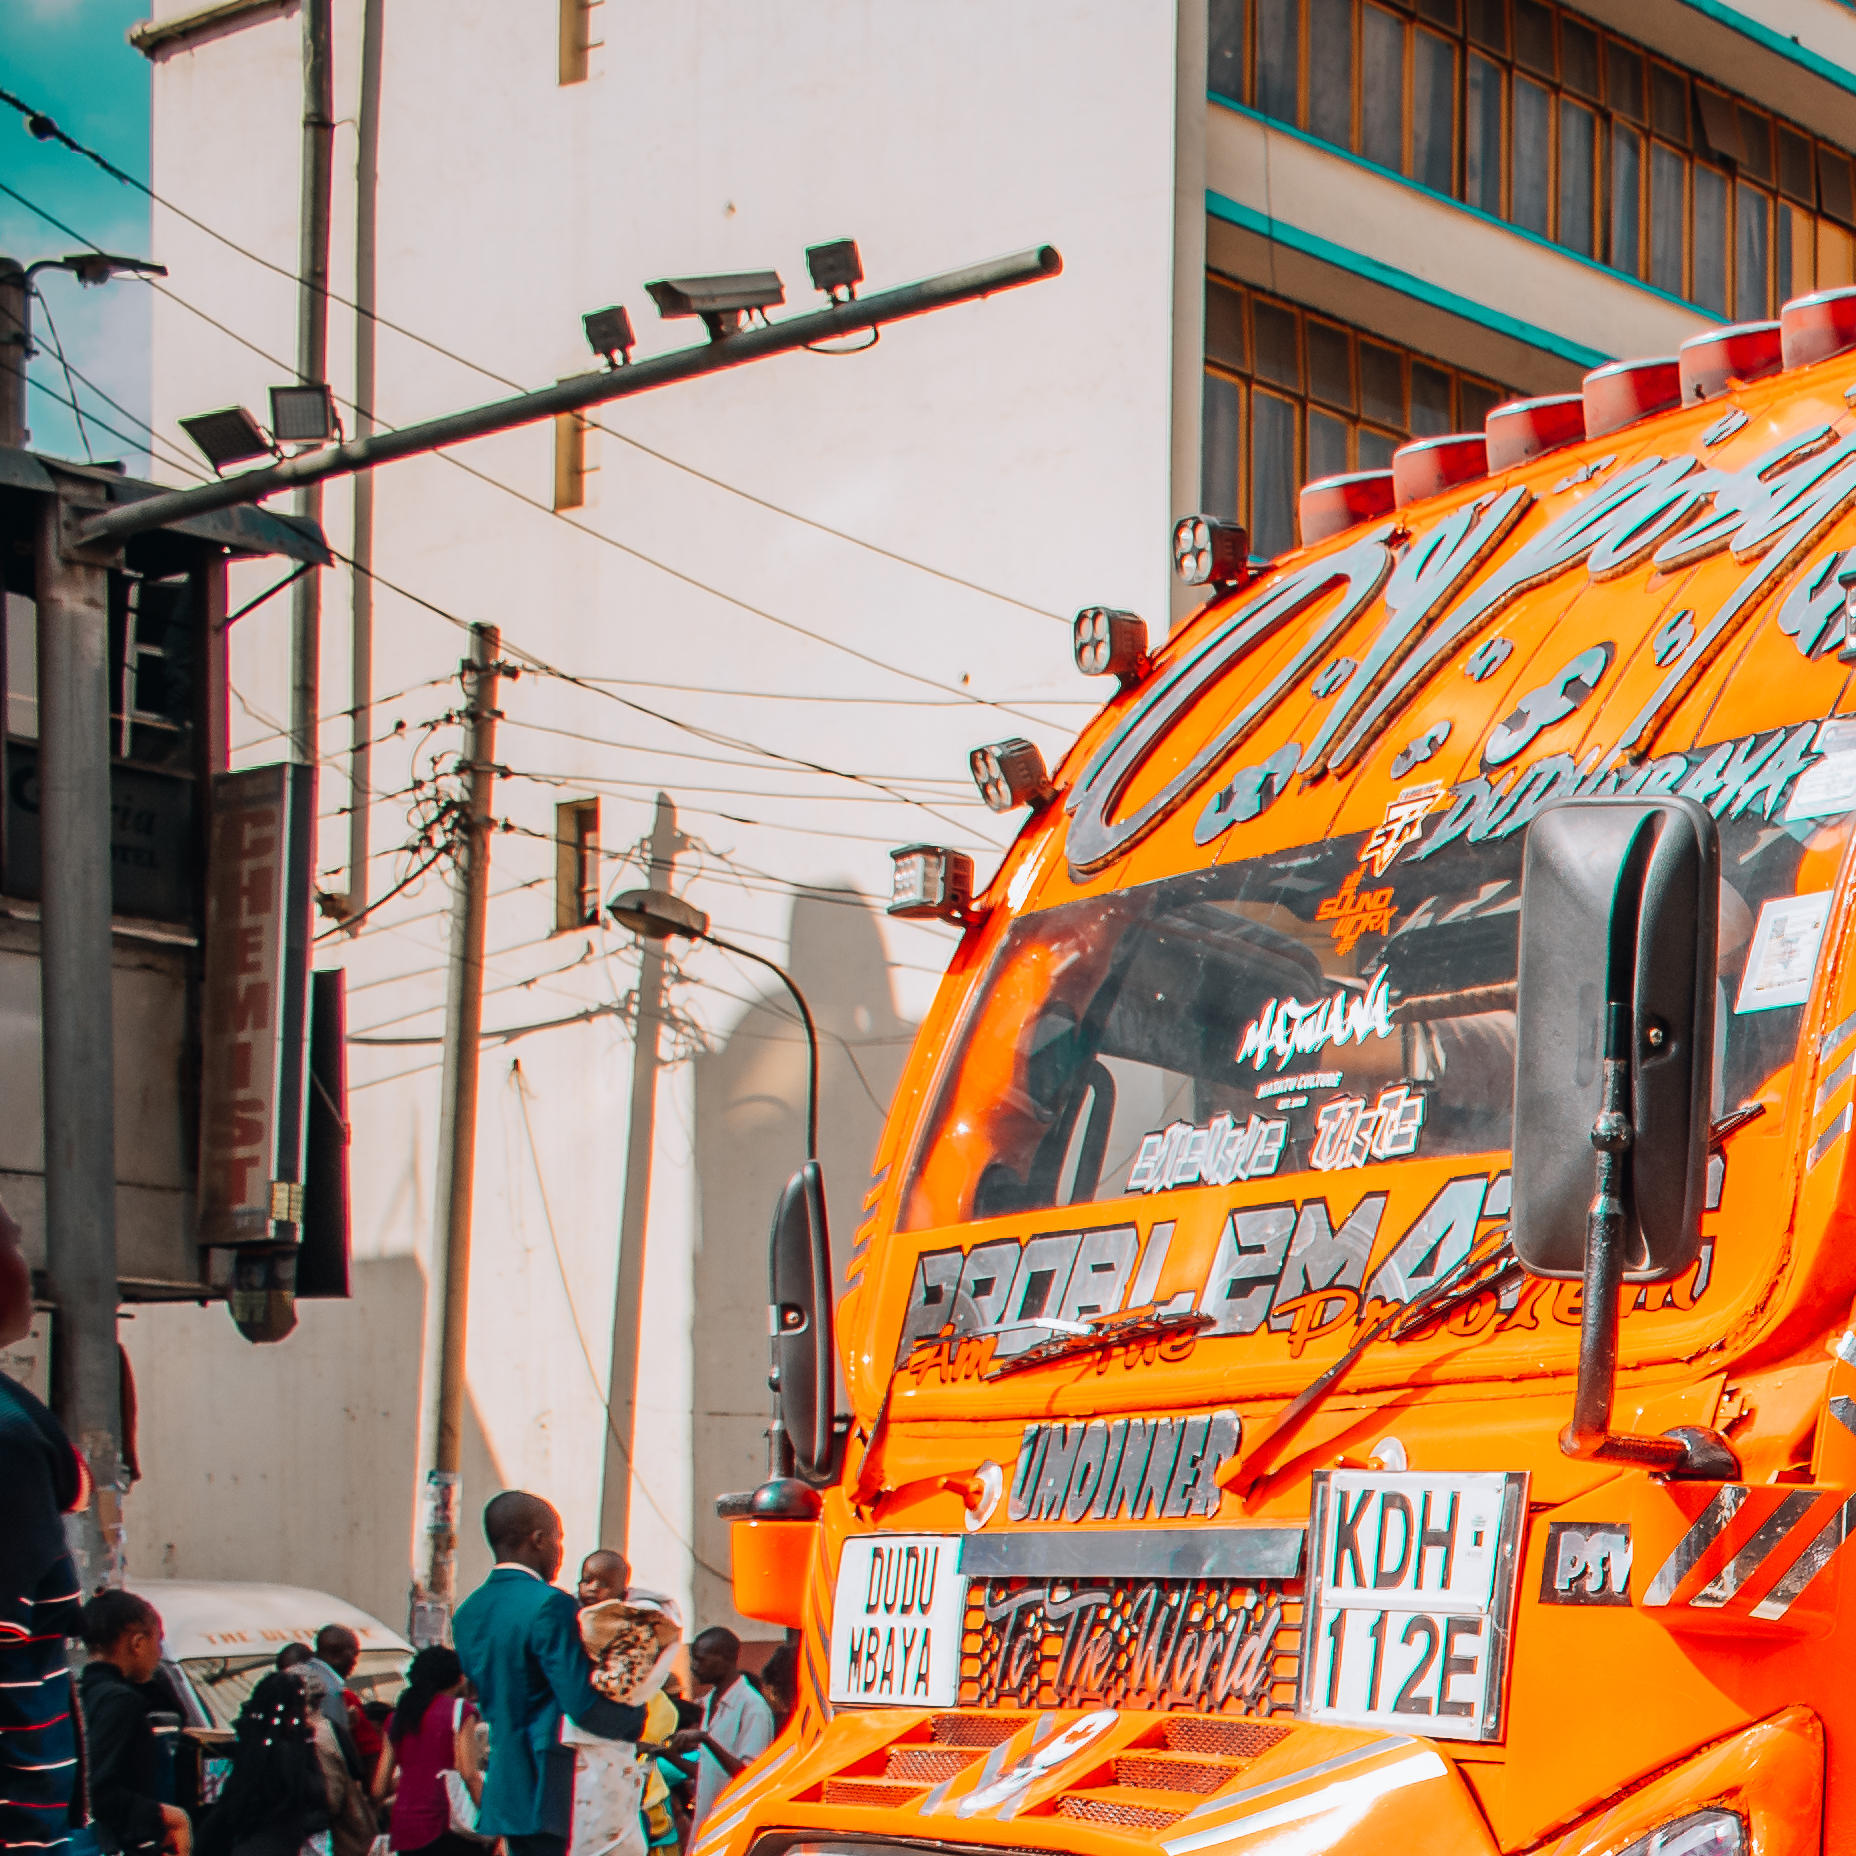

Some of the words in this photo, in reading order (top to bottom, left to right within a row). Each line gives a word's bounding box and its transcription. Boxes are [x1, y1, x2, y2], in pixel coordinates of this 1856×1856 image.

[902, 1150, 1728, 1358] PROBLEMA
[869, 1543, 941, 1616] DUDU
[1332, 1486, 1460, 1594] KDH
[1555, 1527, 1633, 1595] PSV
[847, 1623, 932, 1697] MBAYA
[1128, 1578, 1280, 1700] World
[1320, 1607, 1486, 1717] 112E
